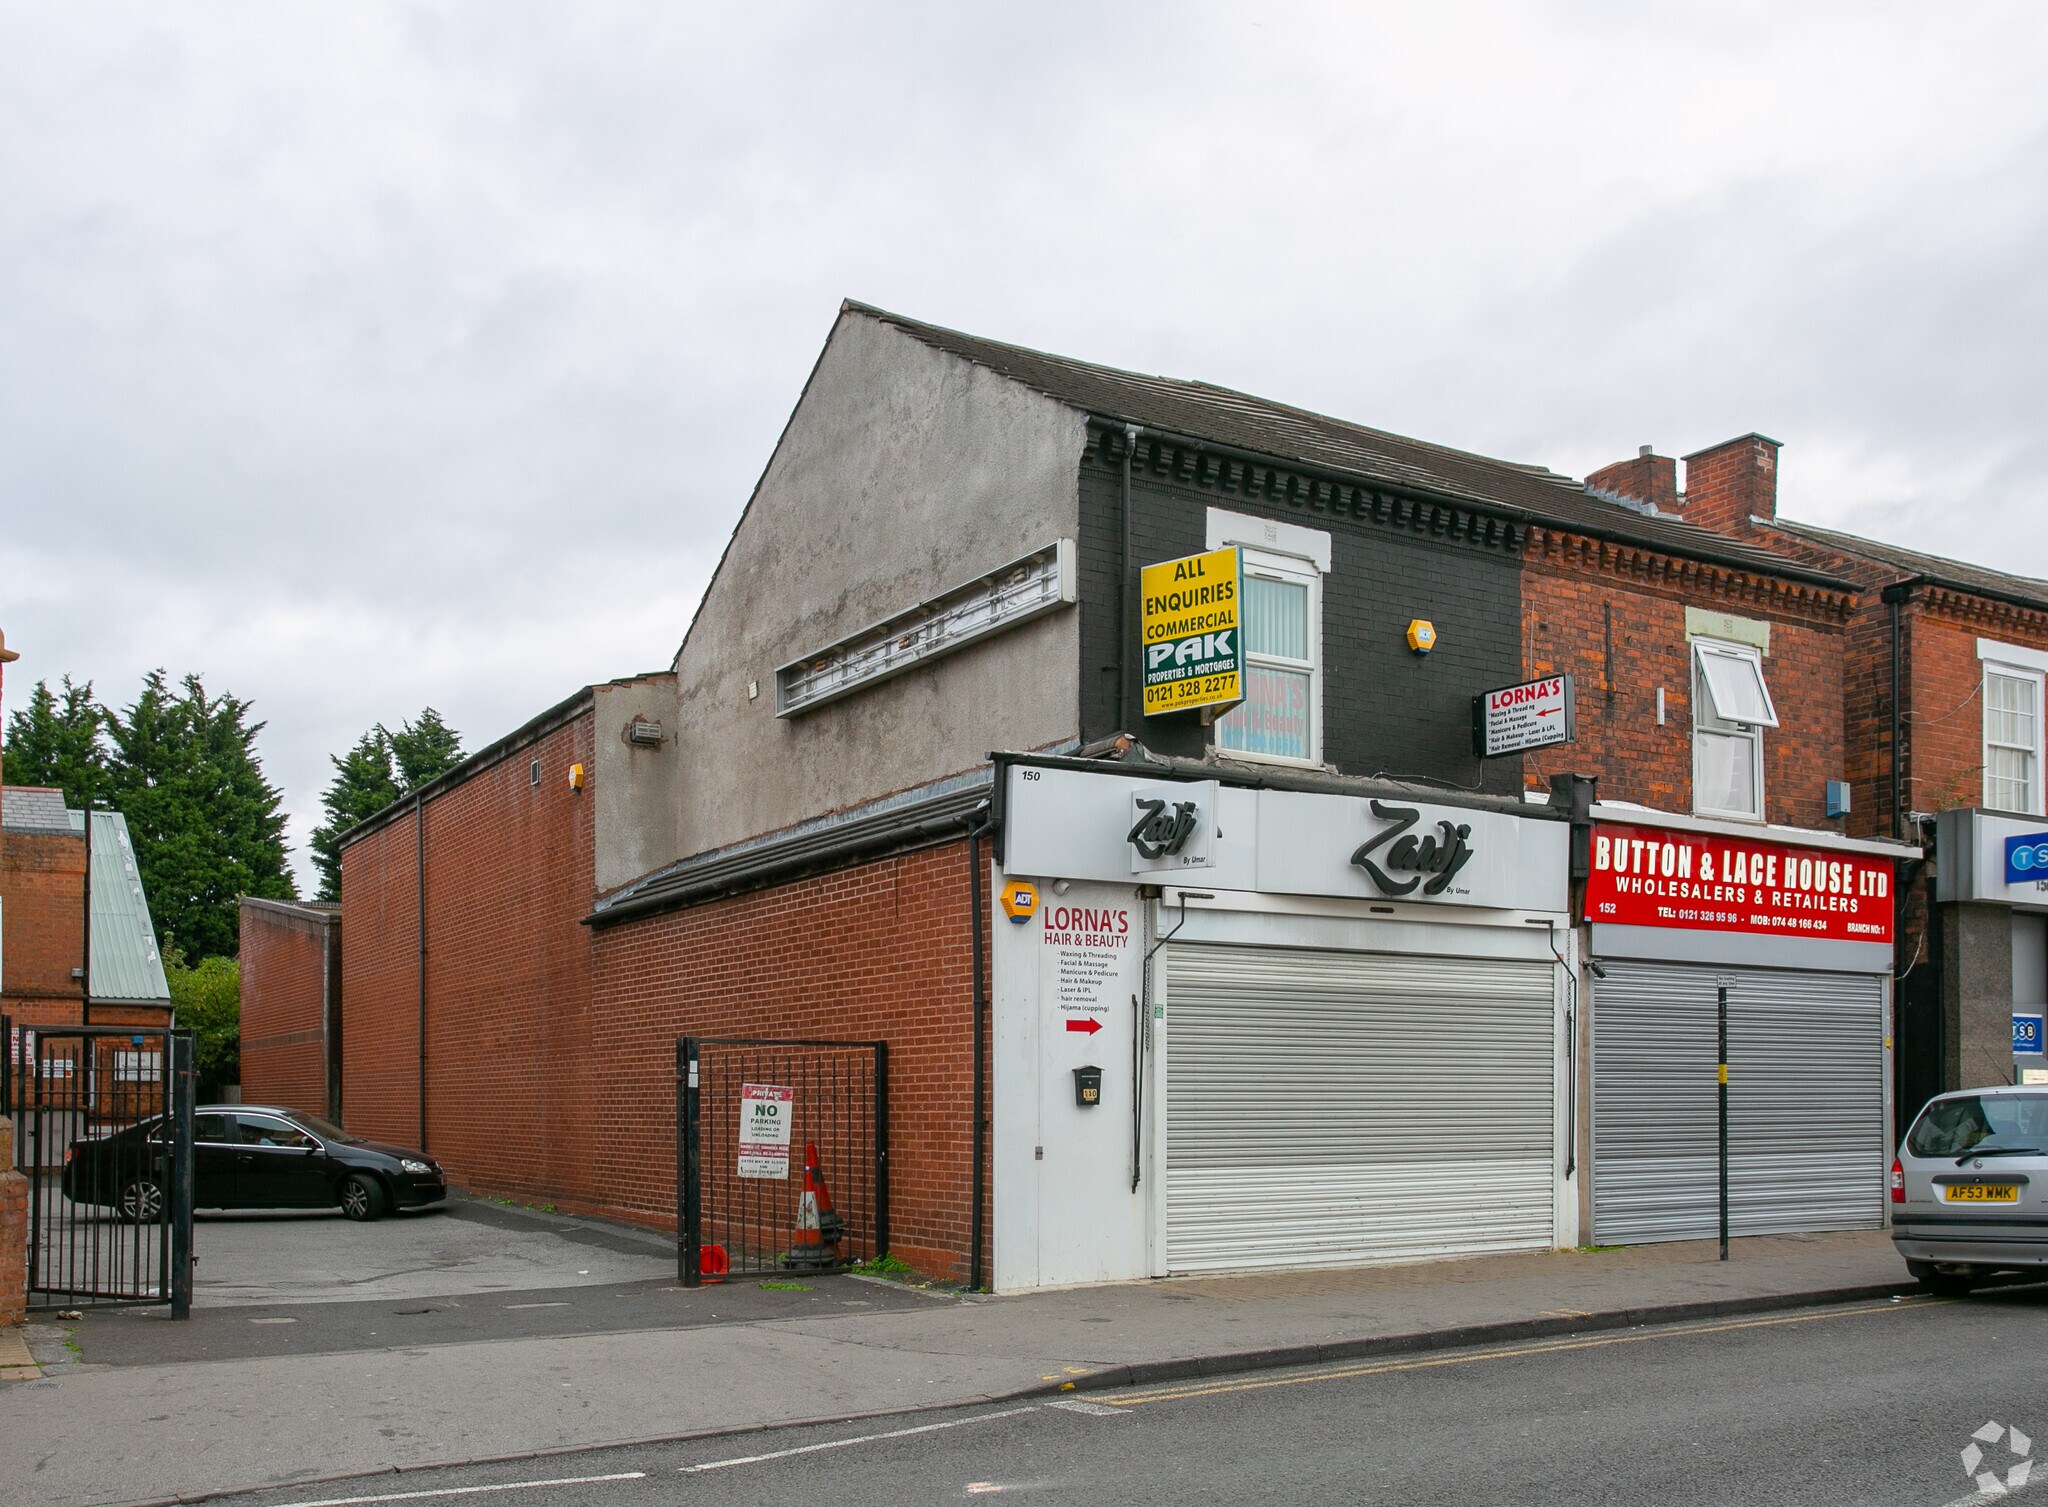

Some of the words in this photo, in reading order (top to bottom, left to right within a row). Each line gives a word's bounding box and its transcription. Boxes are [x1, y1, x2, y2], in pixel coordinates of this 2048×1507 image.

[1174, 558, 1205, 582] ALL
[1146, 580, 1234, 616] ENQUIRIES
[1147, 610, 1234, 640] COMMERCIAL
[1148, 630, 1234, 669] PAK
[1148, 668, 1185, 684] PROPERTIES
[1188, 666, 1192, 676] &
[1195, 659, 1234, 675] MORTGAGES
[1147, 685, 1172, 703] 0121
[1178, 681, 1200, 697] 328
[1205, 675, 1235, 693] 2277
[1492, 679, 1560, 710] LORNA'S
[1162, 693, 1222, 708] www.pakproperties.co.uk
[1509, 714, 1527, 722] Massage
[1517, 721, 1537, 729] Pedicure
[1506, 732, 1524, 740] Makeup
[1022, 771, 1040, 781] 150
[1184, 857, 1190, 865] By
[1595, 836, 1692, 878] BUTTON
[1700, 852, 1714, 881] &
[1722, 850, 1776, 887] LACE
[1784, 857, 1853, 894] HOUSE
[1859, 870, 1888, 898] LTD
[1015, 894, 1031, 905] ADT
[1616, 876, 1745, 903] WHOLESALERS
[1754, 890, 1763, 904] &
[1772, 891, 1858, 913] RETAILERS
[1599, 903, 1616, 913] 152
[1045, 906, 1128, 933] LORNA'S
[1658, 906, 1676, 918] TEL:
[1678, 909, 1698, 920] 0121
[1700, 911, 1714, 921] 326
[1716, 912, 1726, 922] 95
[1727, 913, 1737, 923] 96
[1750, 915, 1770, 926] MOB:
[1772, 916, 1786, 926] 074
[1787, 918, 1796, 928] 48
[1799, 919, 1812, 929] 166
[1813, 920, 1827, 930] 434
[1847, 923, 1870, 933] BRANCH
[1871, 924, 1881, 934] NO:
[1881, 925, 1885, 934] 1
[1045, 932, 1071, 945] HAIR
[1074, 934, 1082, 946] &
[1086, 934, 1128, 948] BEAUTY
[1088, 952, 1117, 960] Threading
[756, 1104, 778, 1116] NO
[1951, 1187, 1983, 1198] AF53
[1986, 1187, 2011, 1198] WMK
